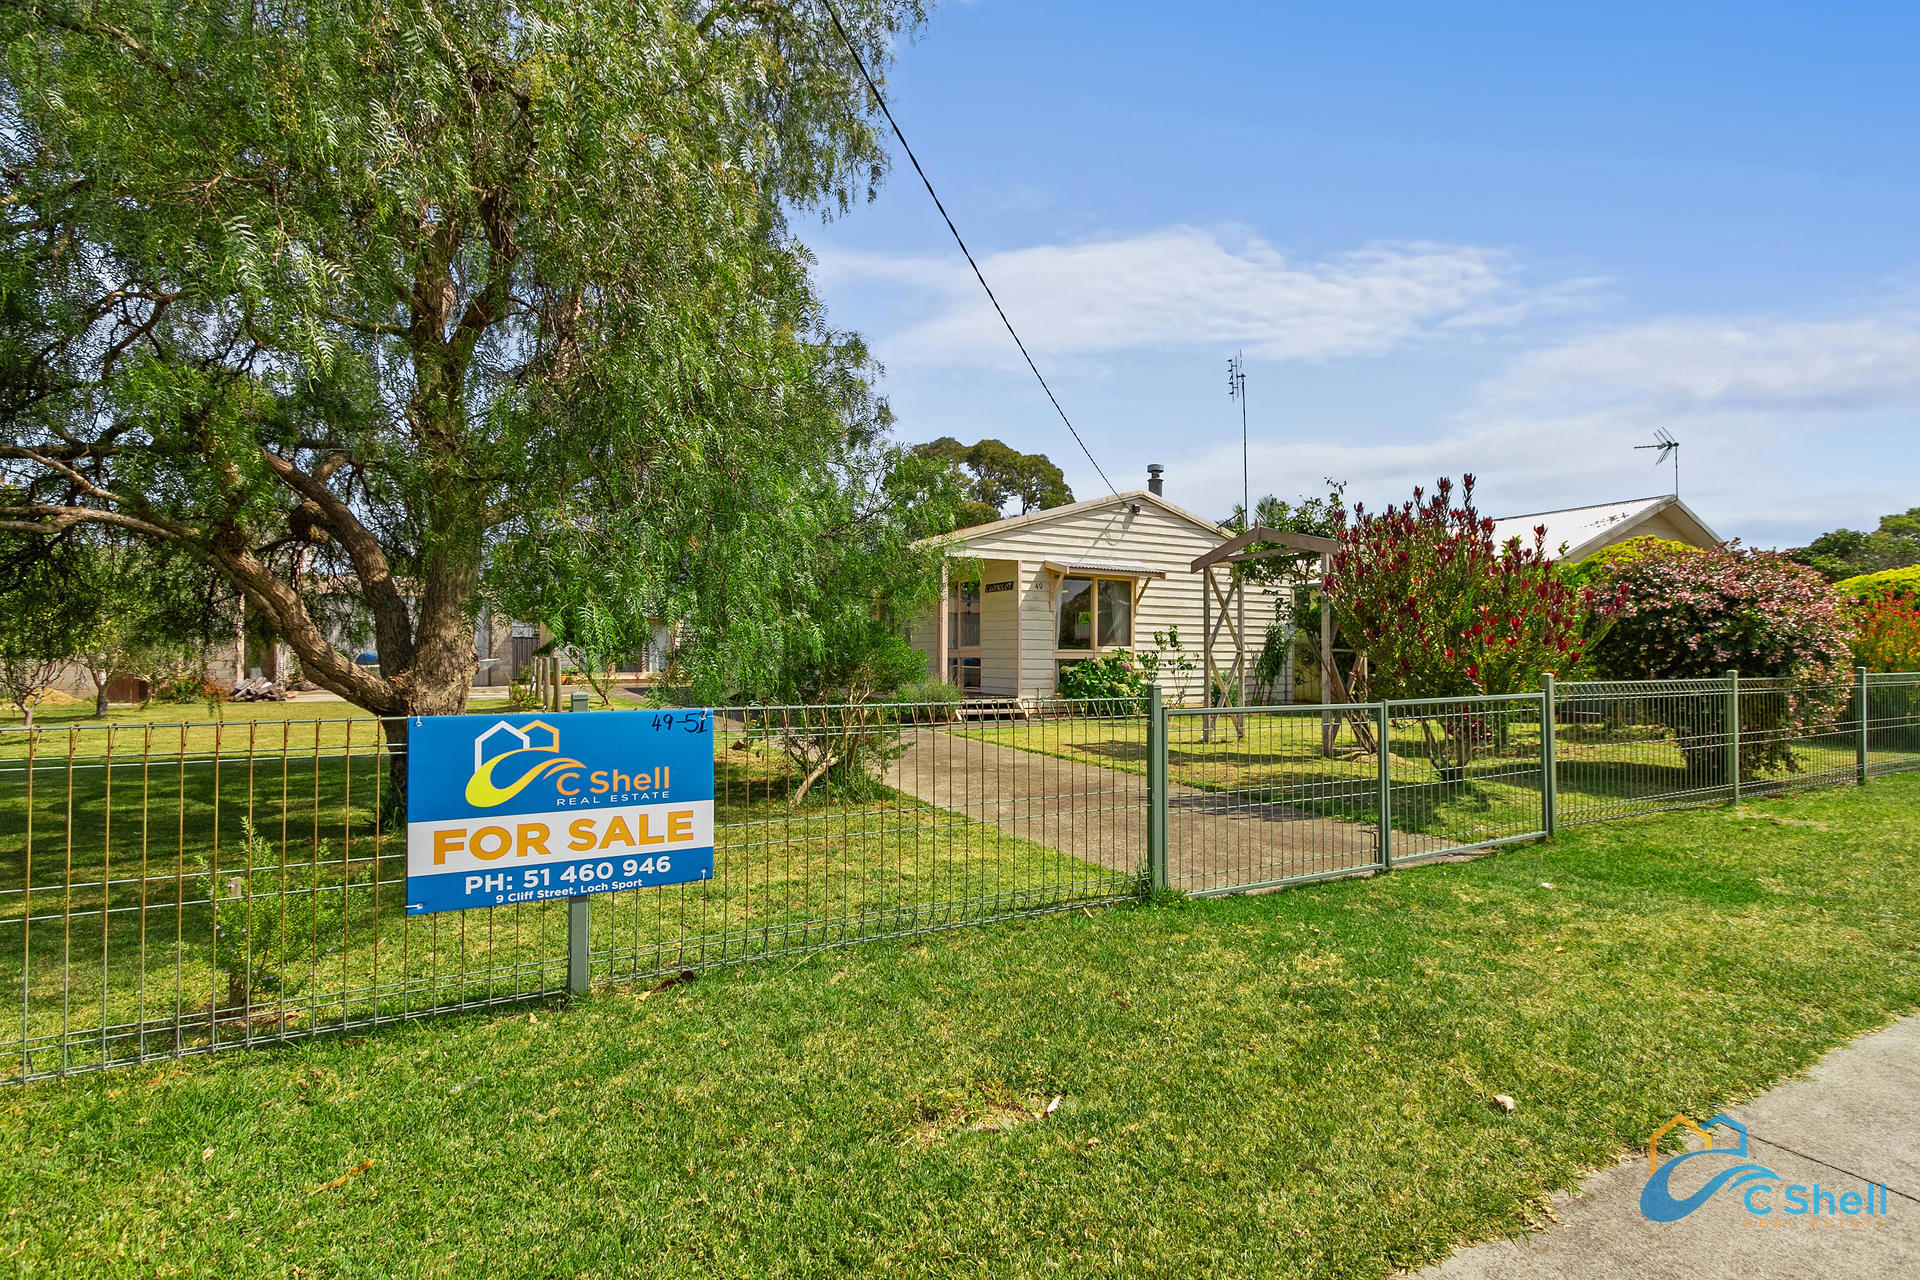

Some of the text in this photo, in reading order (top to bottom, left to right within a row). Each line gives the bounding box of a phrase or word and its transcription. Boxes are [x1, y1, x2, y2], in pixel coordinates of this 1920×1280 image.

[556, 766, 670, 796] C Shell
[556, 791, 670, 806] REAL ESTATE
[433, 810, 694, 866] FOR SALE
[465, 855, 671, 895] PH: 51 460 946
[495, 878, 643, 904] 9 Cliff Street, Loch Sport
